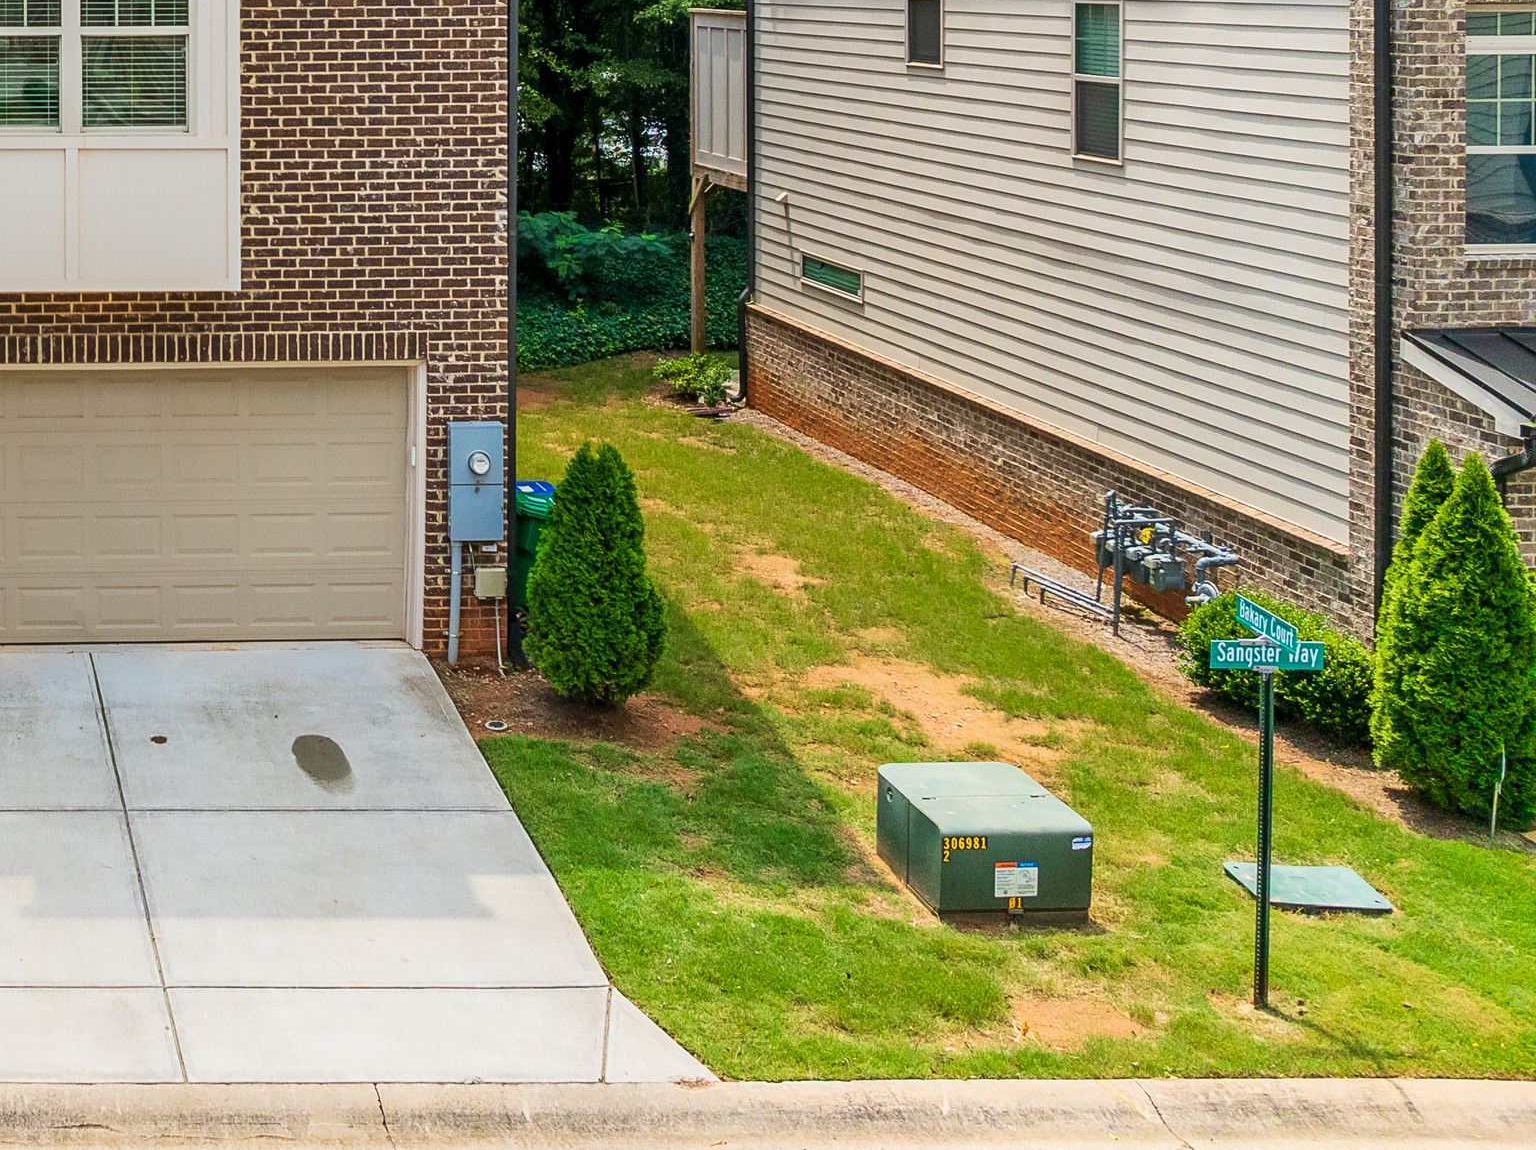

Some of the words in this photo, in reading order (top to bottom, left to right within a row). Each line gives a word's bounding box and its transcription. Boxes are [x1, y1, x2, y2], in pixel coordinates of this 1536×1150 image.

[1239, 598, 1268, 635] Bakary
[1270, 617, 1294, 648] Court
[1217, 641, 1282, 668] Sangster
[943, 836, 987, 850] 306981
[943, 850, 950, 862] 2
